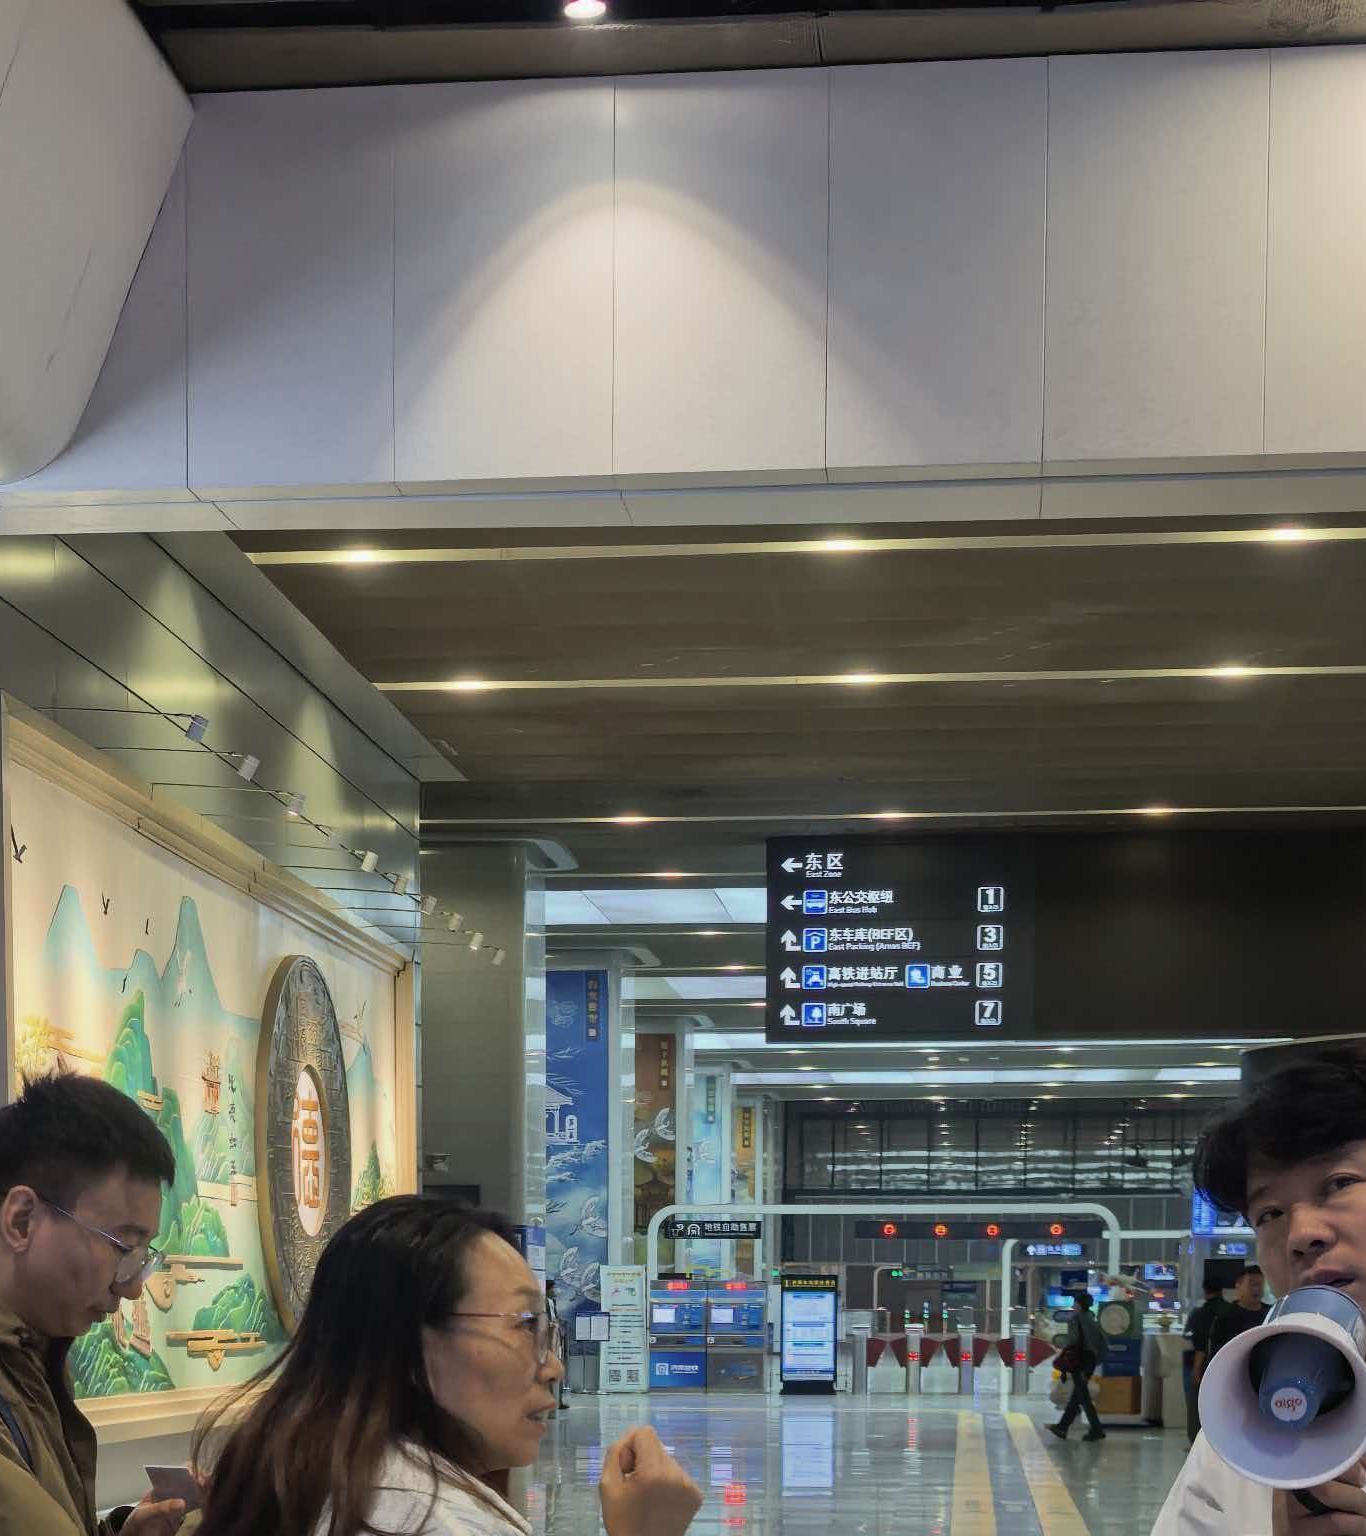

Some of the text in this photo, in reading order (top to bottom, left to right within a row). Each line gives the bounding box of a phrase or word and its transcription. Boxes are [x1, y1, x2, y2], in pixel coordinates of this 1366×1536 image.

[805, 853, 843, 870] 东区
[829, 891, 894, 904] 东公交枢纽
[985, 889, 995, 905] 1
[983, 927, 996, 942] 3
[982, 964, 996, 981] 5
[981, 1002, 995, 1018] 7
